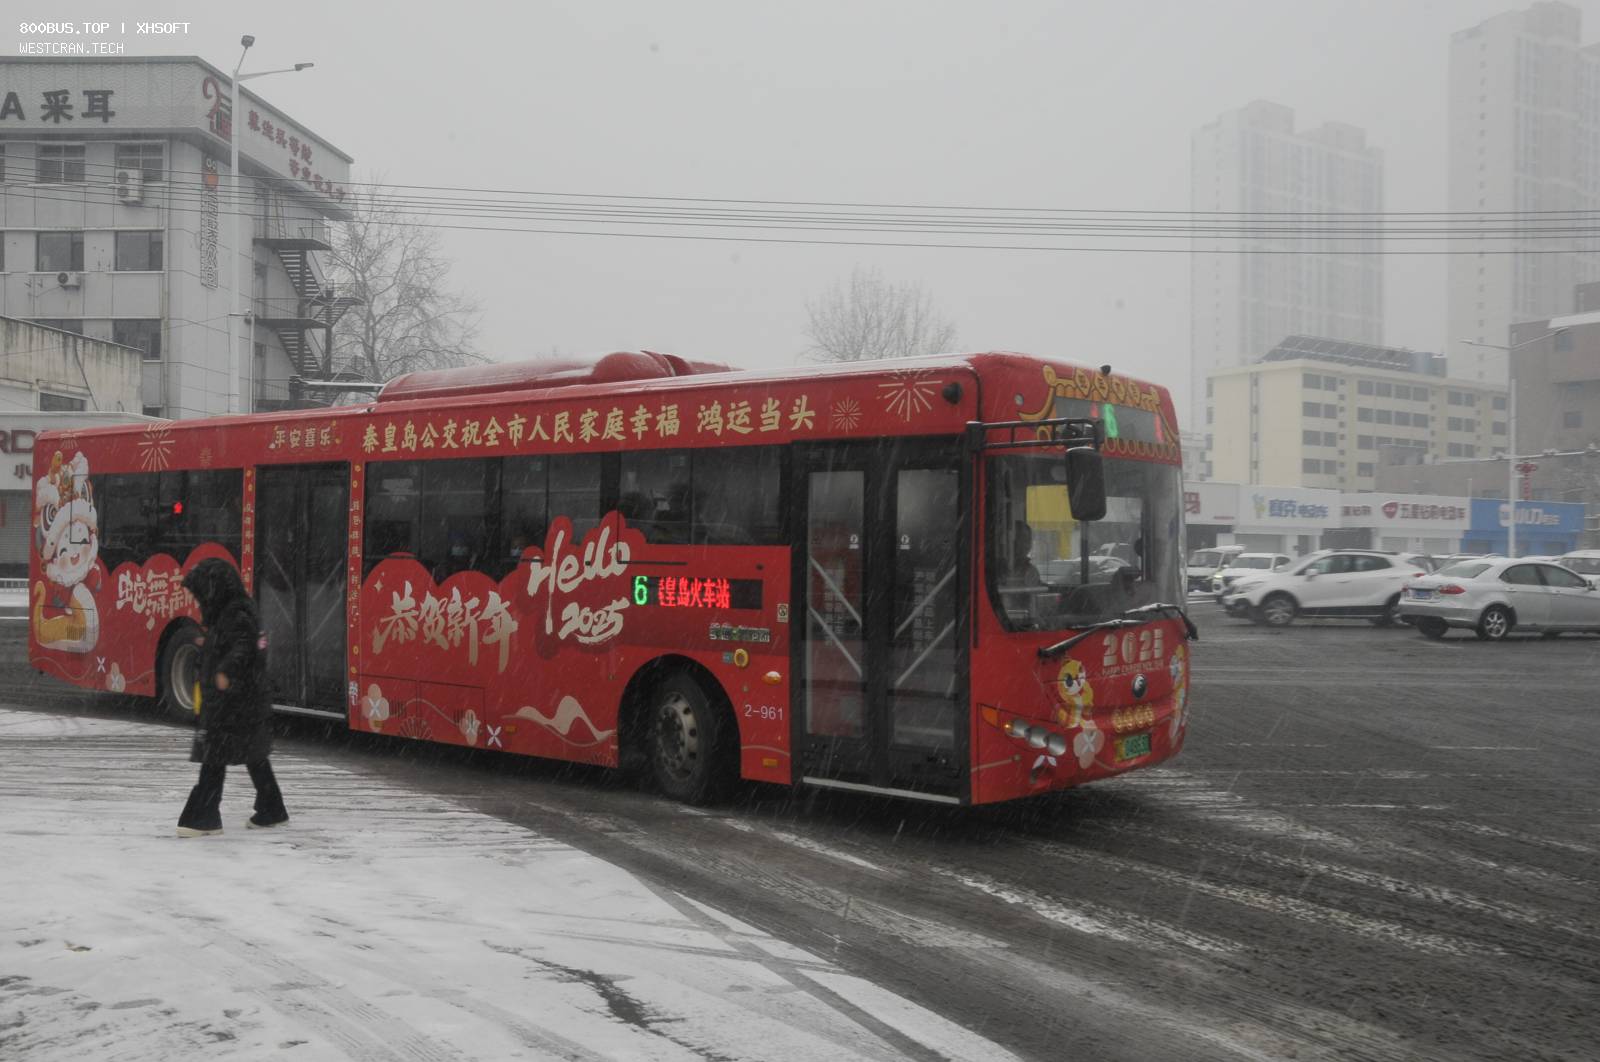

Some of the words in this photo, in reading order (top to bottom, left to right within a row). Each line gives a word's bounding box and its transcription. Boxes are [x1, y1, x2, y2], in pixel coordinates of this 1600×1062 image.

[634, 575, 649, 606] 6
[558, 596, 631, 643] 2025
[744, 704, 784, 721] 2-961
